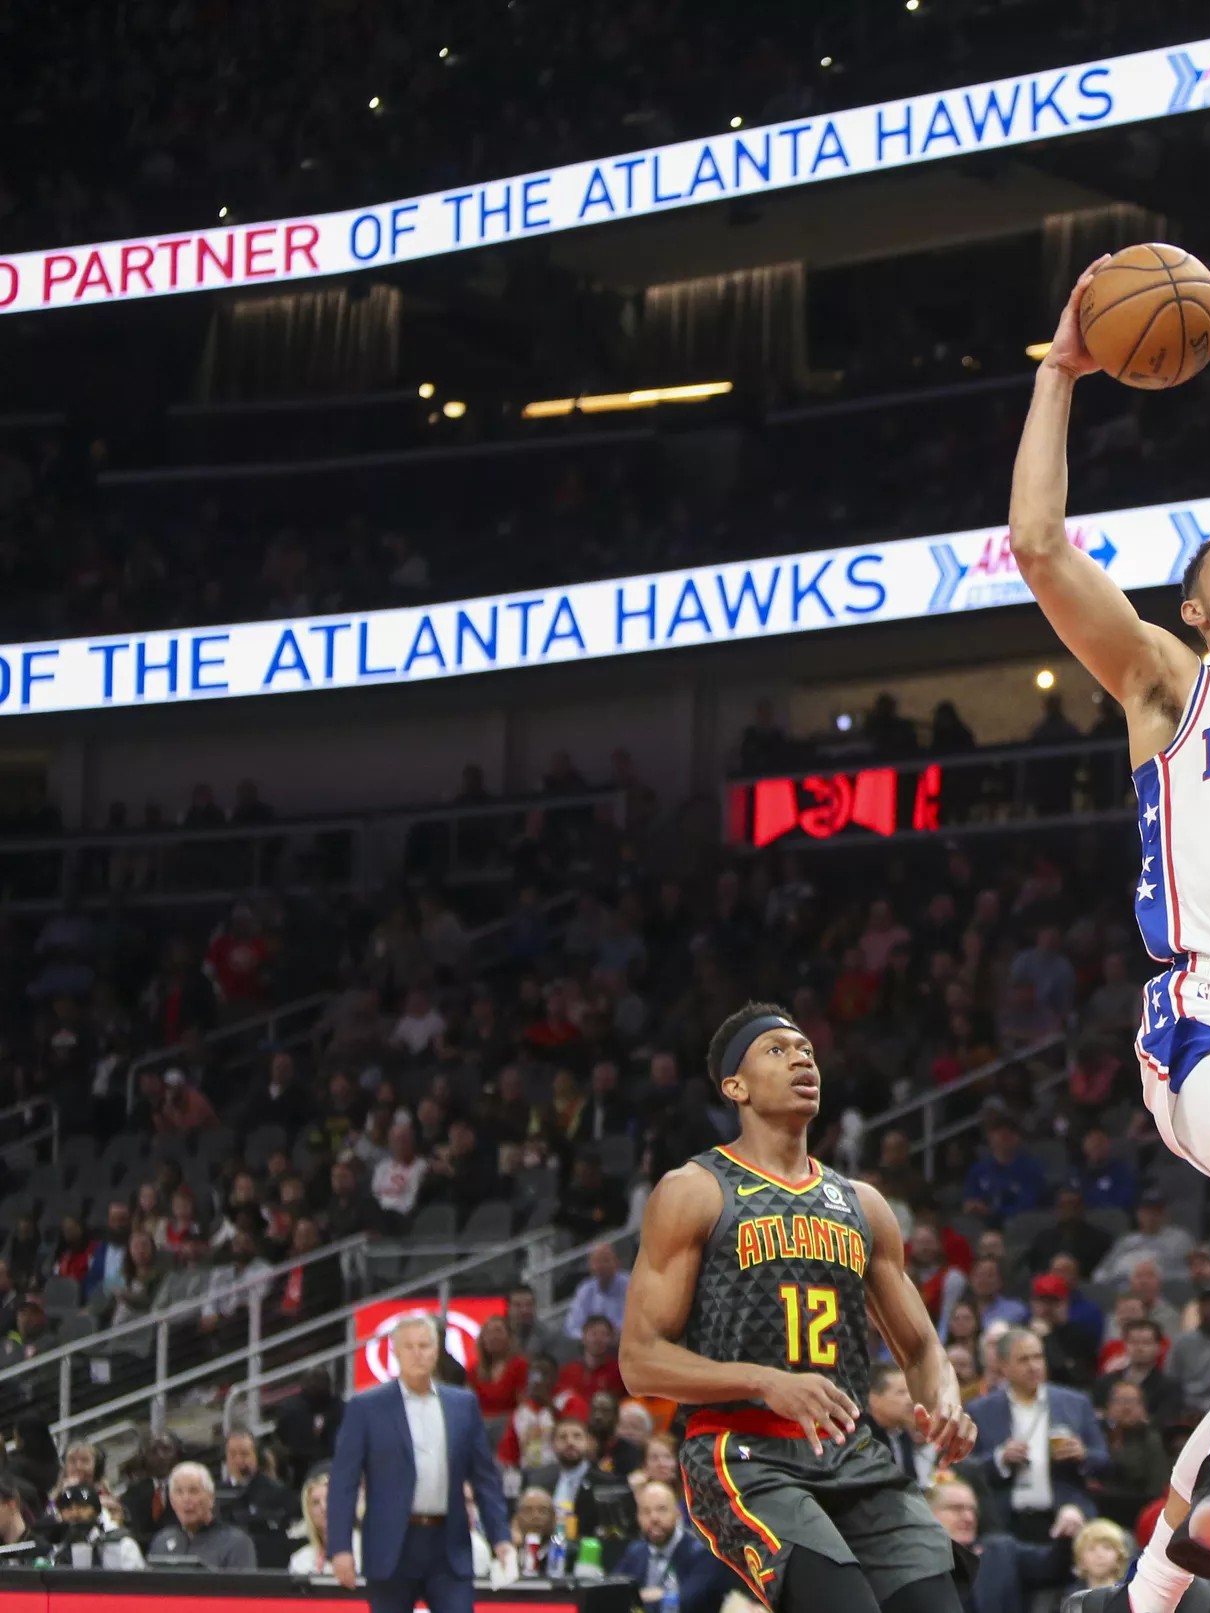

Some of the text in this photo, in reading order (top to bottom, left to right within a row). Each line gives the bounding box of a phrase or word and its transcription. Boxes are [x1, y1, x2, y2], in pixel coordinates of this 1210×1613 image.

[43, 224, 320, 304] PARTNER
[351, 204, 418, 260] OF
[443, 177, 551, 243] THE
[579, 120, 849, 218] ATLANTA
[875, 68, 1114, 161] HAWKS
[0, 554, 887, 706] F THE ATLANTA HAWKS
[736, 1215, 866, 1279] ATLANTA
[778, 1283, 838, 1367] 12
